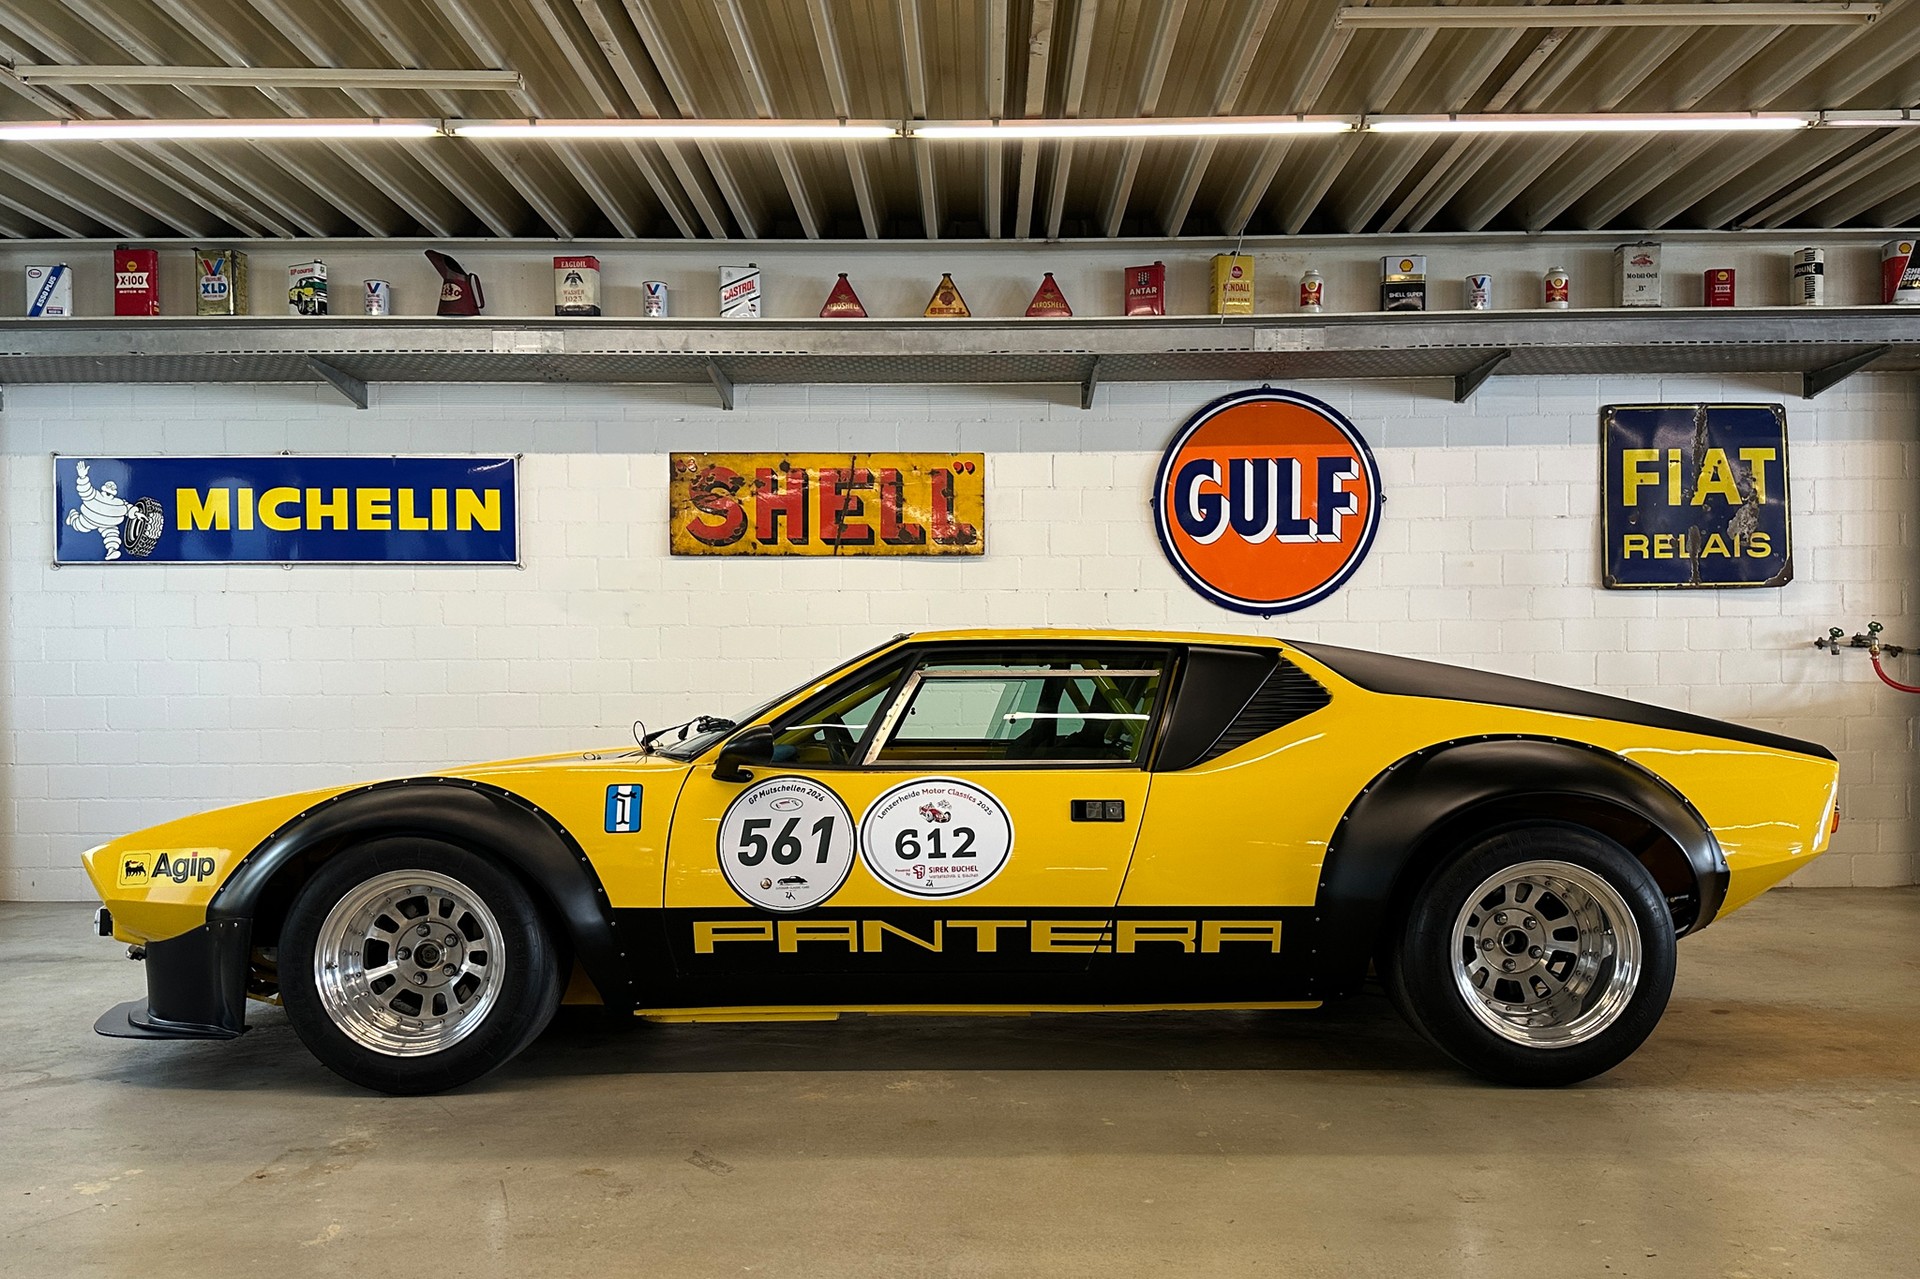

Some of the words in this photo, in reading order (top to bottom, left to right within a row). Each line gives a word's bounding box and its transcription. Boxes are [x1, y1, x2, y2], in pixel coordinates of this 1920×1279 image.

[1804, 250, 1816, 262] OIL
[36, 290, 49, 307] ESSO
[44, 275, 57, 292] PLUS
[201, 283, 227, 294] XLD
[1130, 286, 1158, 296] ANTAR
[1804, 275, 1816, 300] MOTOR
[929, 307, 966, 315] SHELL
[1032, 301, 1066, 309] AEROSHELL
[1622, 447, 1777, 507] FIAT
[176, 487, 501, 531] MICHELIN
[1174, 456, 1360, 545] GULF
[1623, 532, 1772, 560] RELAIS
[748, 794, 759, 805] GP
[758, 784, 806, 798] Mutschellen
[877, 791, 921, 820] Lenzerheide
[947, 788, 977, 803] Classics
[976, 800, 993, 816] 2025
[737, 816, 836, 867] 561
[895, 827, 977, 860] 612
[151, 851, 216, 884] Agip
[928, 866, 949, 874] SIREK
[692, 919, 1283, 954] PANTERA
